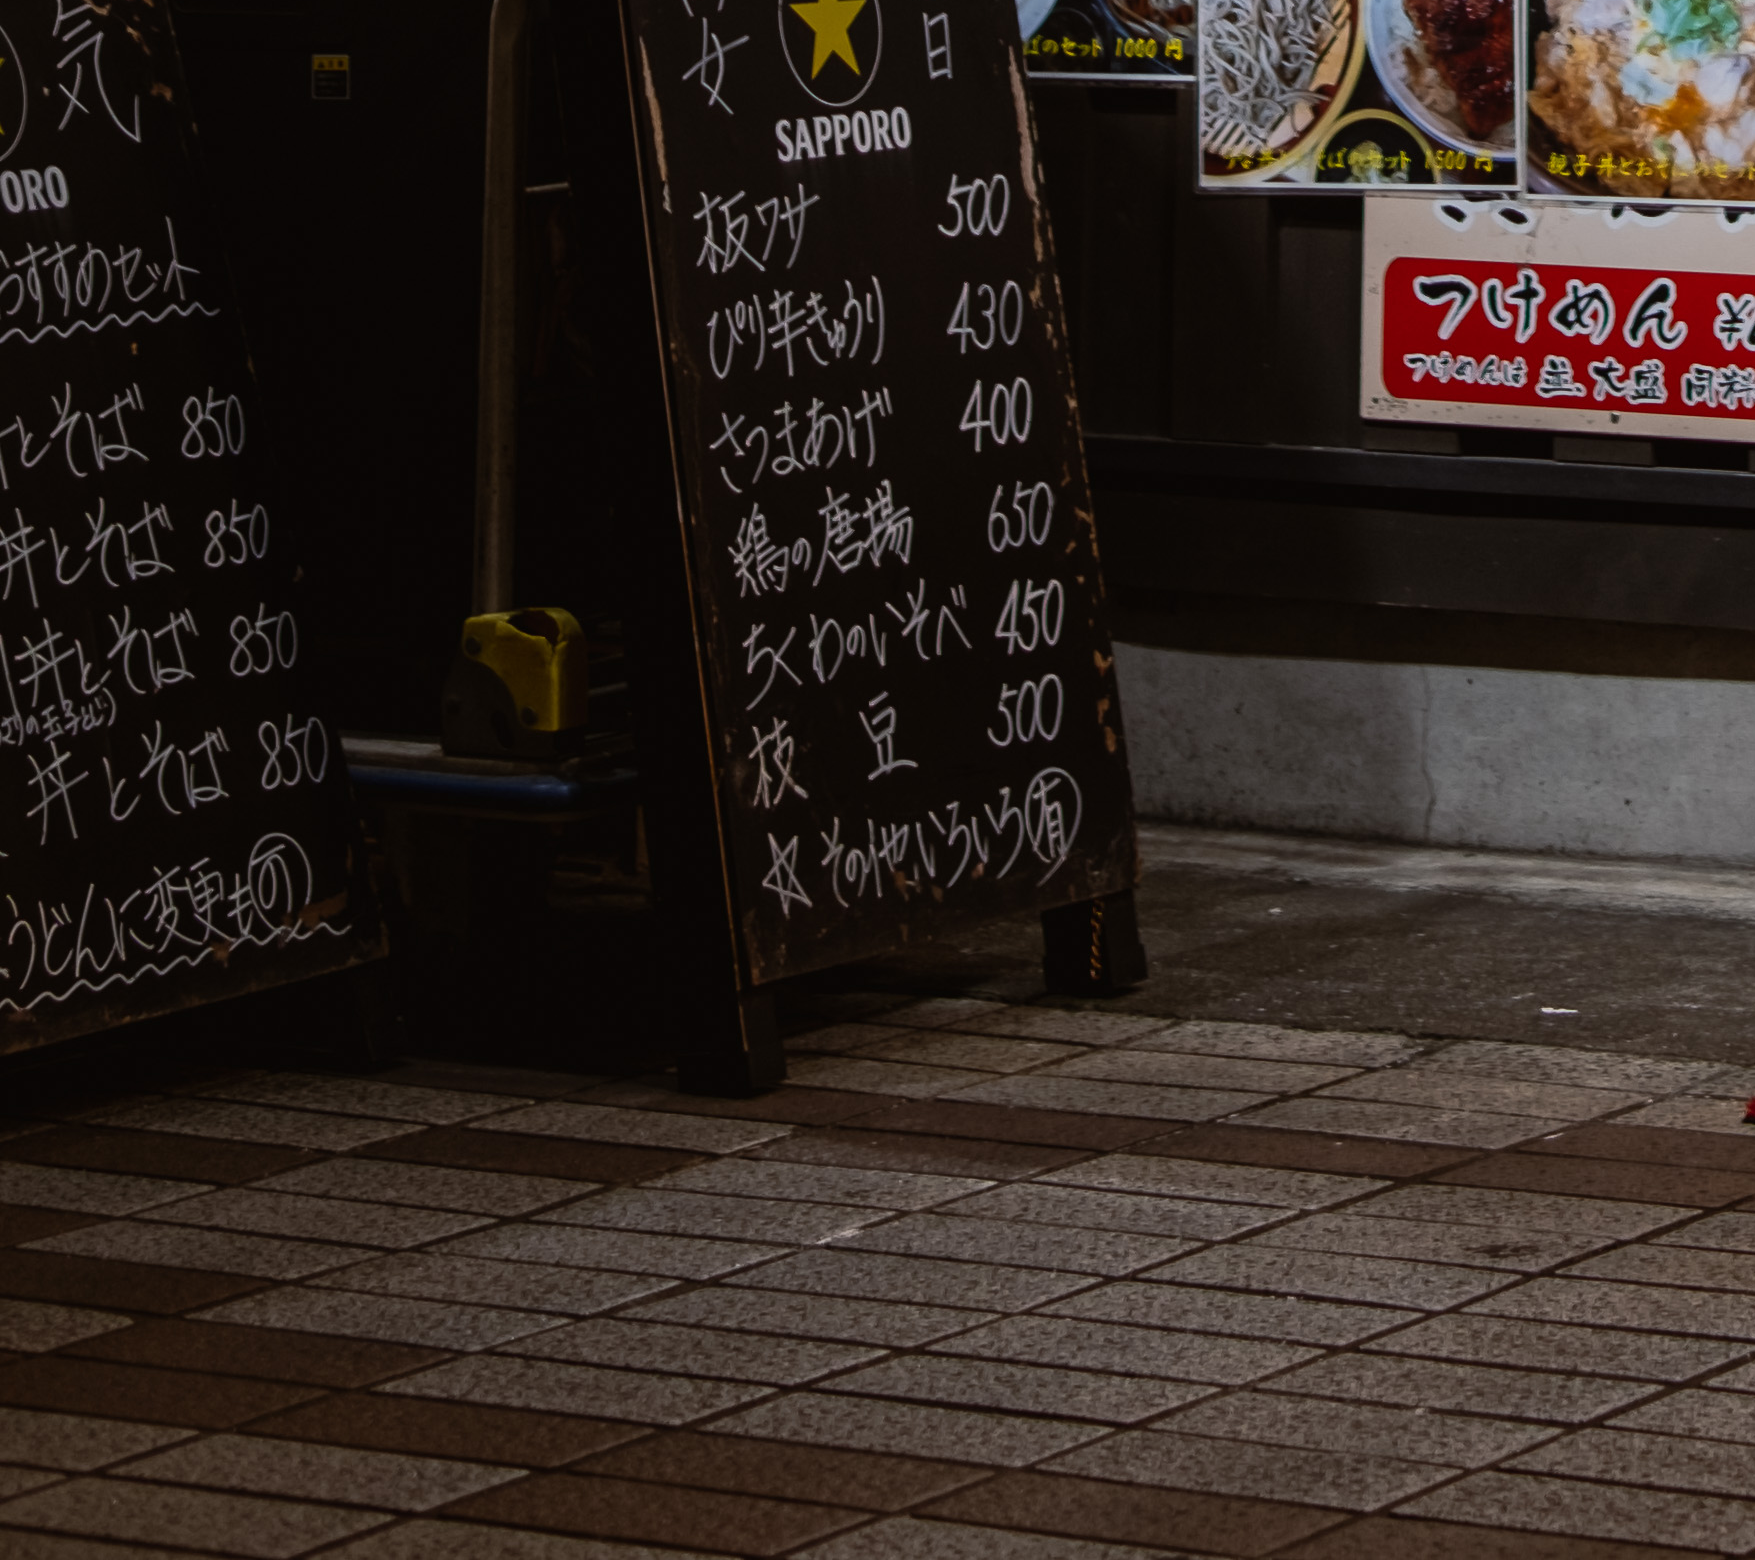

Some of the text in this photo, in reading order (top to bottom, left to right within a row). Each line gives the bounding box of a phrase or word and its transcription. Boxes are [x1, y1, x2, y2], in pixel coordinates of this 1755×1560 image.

[1165, 37, 1185, 62] 円
[774, 106, 913, 163] SAPPORO
[937, 172, 1011, 239] 500
[946, 279, 1024, 355] 430
[1412, 269, 1688, 351] つけめん
[181, 386, 246, 459] 850
[708, 375, 1033, 494] さつまあげ 400
[203, 498, 270, 568] 850
[986, 480, 1055, 553] 650
[994, 578, 1066, 657] 450
[0, 602, 300, 717] 丼とそば 850
[986, 672, 1065, 748] 500
[258, 714, 329, 792] 850
